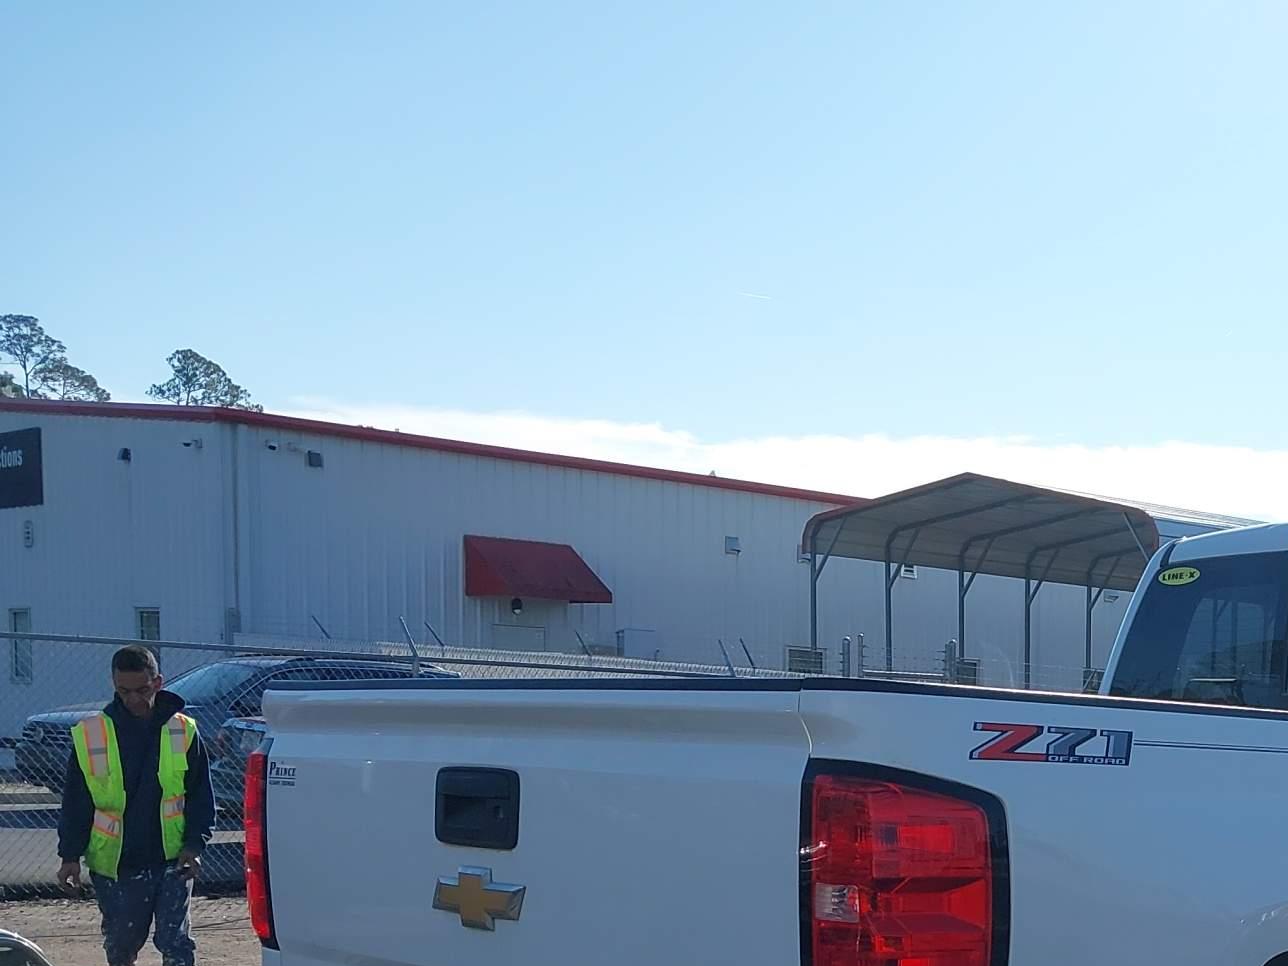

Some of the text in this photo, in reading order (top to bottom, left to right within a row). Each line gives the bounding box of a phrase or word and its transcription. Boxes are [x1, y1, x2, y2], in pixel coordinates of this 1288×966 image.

[0, 446, 23, 468] tions
[1161, 571, 1197, 581] LINE-X
[968, 721, 1133, 765] Z71
[1048, 755, 1126, 765] OFF ROAD
